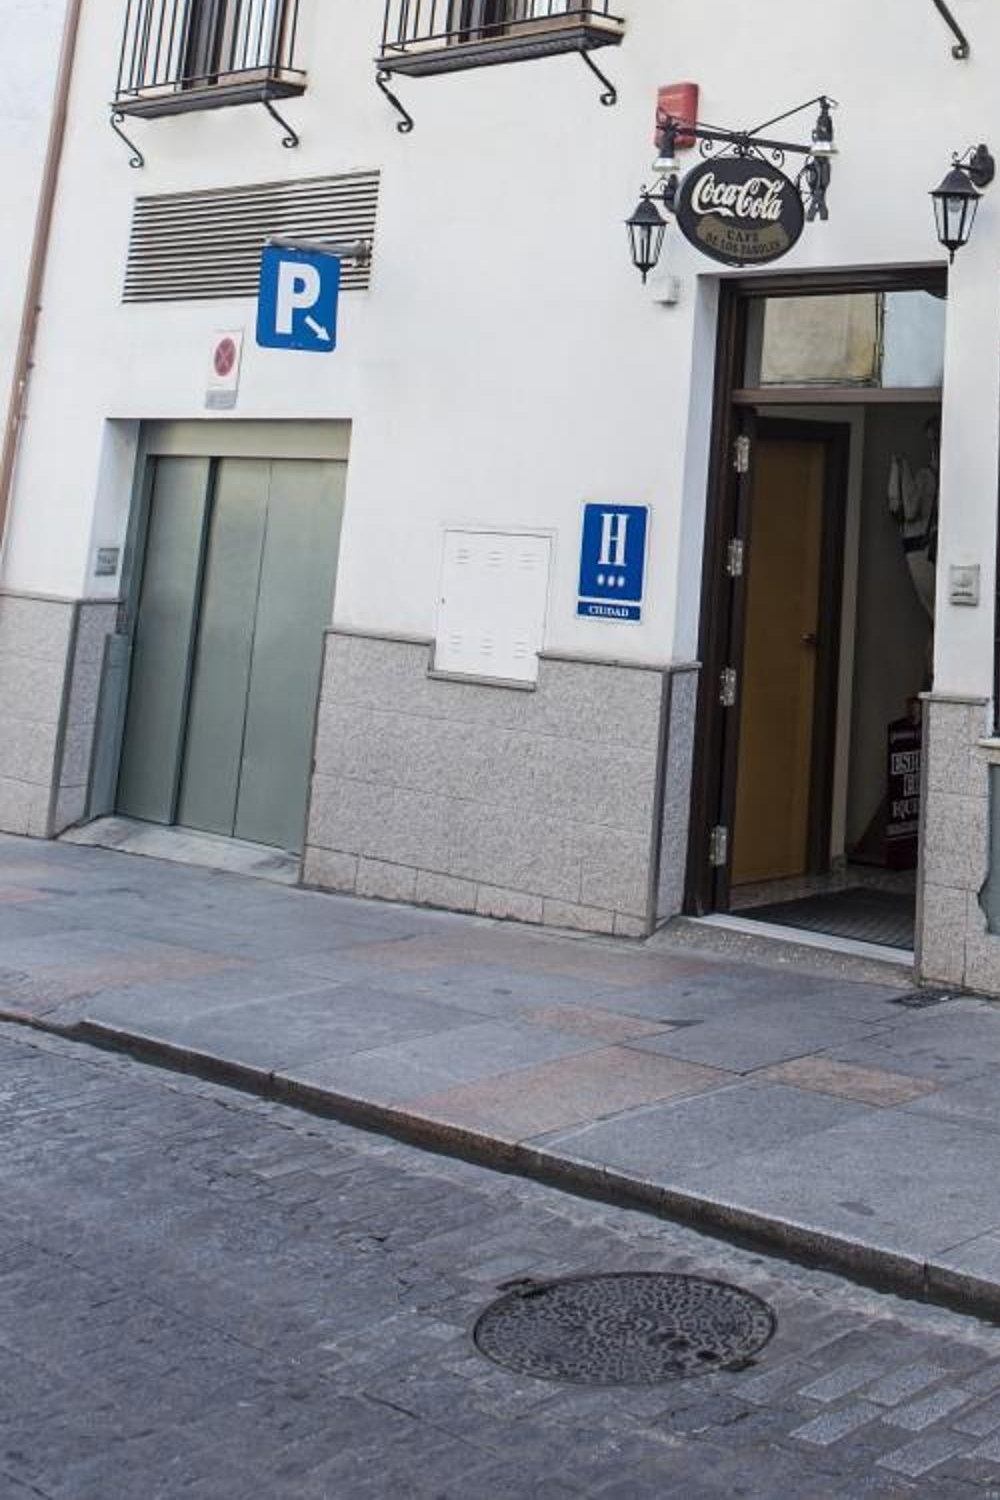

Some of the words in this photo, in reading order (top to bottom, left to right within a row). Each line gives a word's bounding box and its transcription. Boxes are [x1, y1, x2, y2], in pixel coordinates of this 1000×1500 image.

[275, 259, 321, 335] P
[597, 513, 630, 567] H
[588, 605, 629, 617] CIUDAD
